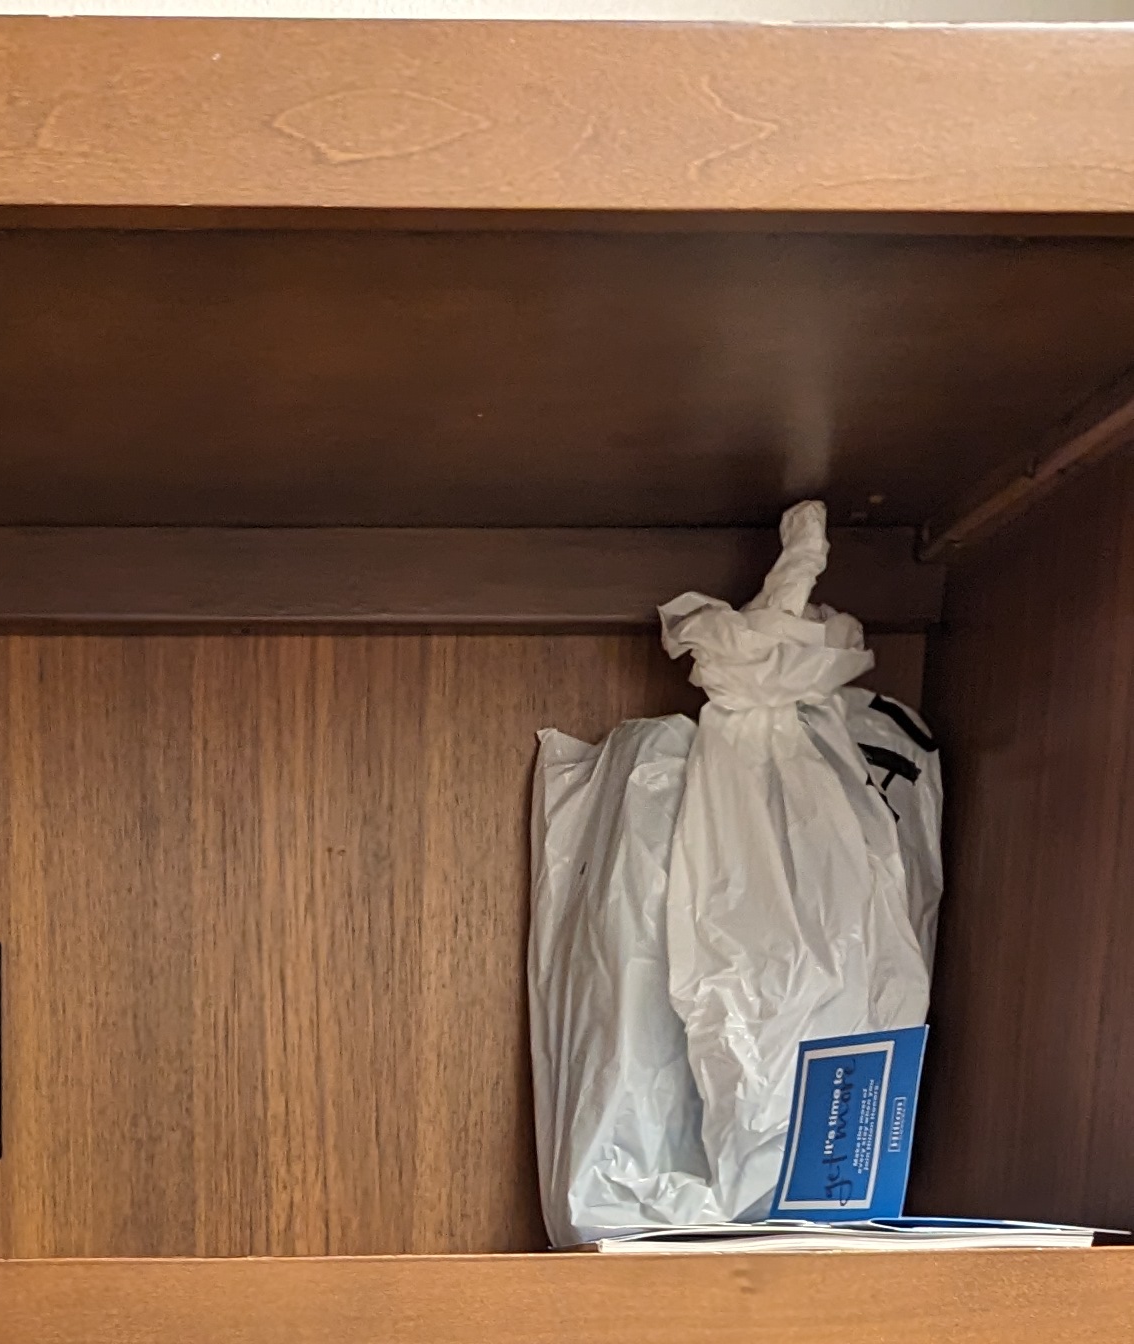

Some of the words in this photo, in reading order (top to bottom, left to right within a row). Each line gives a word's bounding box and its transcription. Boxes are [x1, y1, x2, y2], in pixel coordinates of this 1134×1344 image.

[833, 1067, 844, 1085] to
[828, 1089, 841, 1127] time
[890, 1101, 903, 1148] Hilton
[823, 1129, 836, 1155] It's
